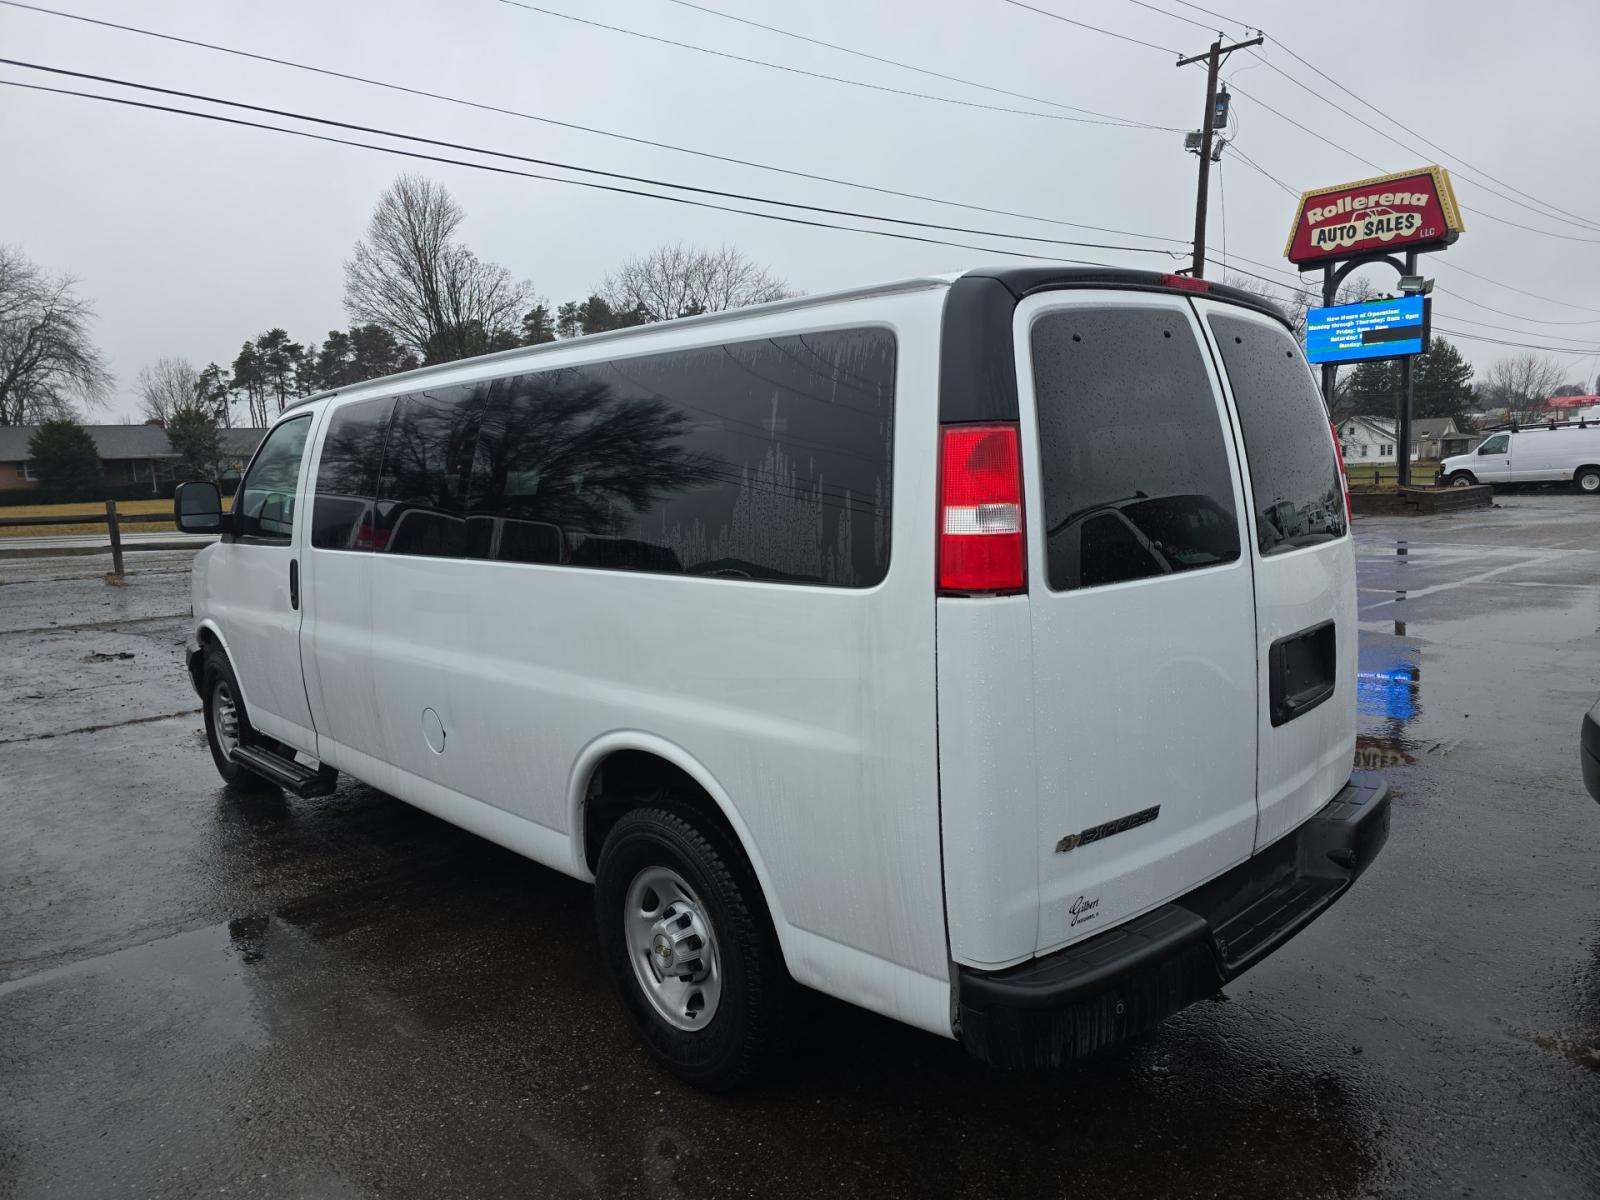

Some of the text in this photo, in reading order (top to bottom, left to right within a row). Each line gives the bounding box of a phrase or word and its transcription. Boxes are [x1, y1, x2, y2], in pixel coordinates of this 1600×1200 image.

[1307, 192, 1429, 226] Rollerena
[1317, 213, 1415, 245] AUTO SALES
[1419, 227, 1435, 238] LLC
[1367, 309, 1400, 318] Operation:
[1308, 323, 1331, 331] Monday
[1331, 320, 1355, 329] through
[1356, 316, 1386, 326] Thursday:
